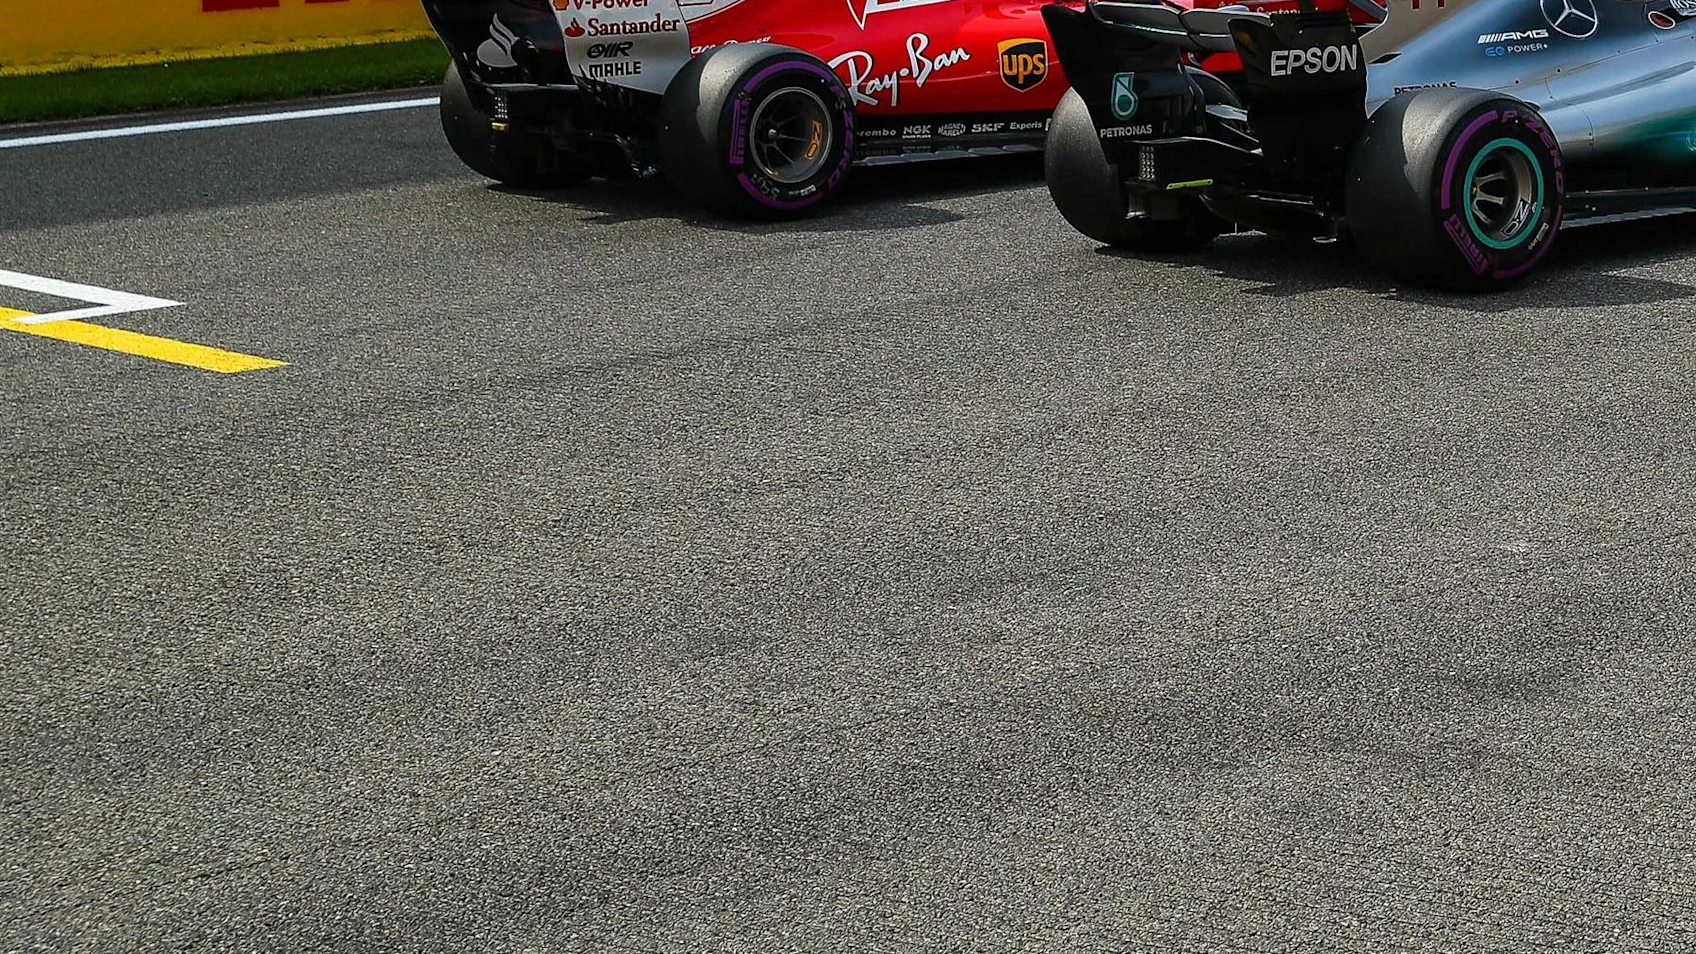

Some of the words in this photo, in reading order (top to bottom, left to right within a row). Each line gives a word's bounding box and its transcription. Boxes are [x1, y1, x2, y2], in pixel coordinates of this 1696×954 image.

[588, 13, 680, 38] Santander
[1500, 29, 1549, 43] AMG
[1271, 44, 1358, 77] EPSON
[589, 61, 642, 78] MAHLE
[1002, 53, 1045, 85] ups
[857, 128, 897, 137] rembo
[903, 125, 932, 135] NGK
[971, 123, 1005, 133] SKF
[1010, 121, 1043, 131] Experis
[1100, 124, 1153, 138] PETRONAS
